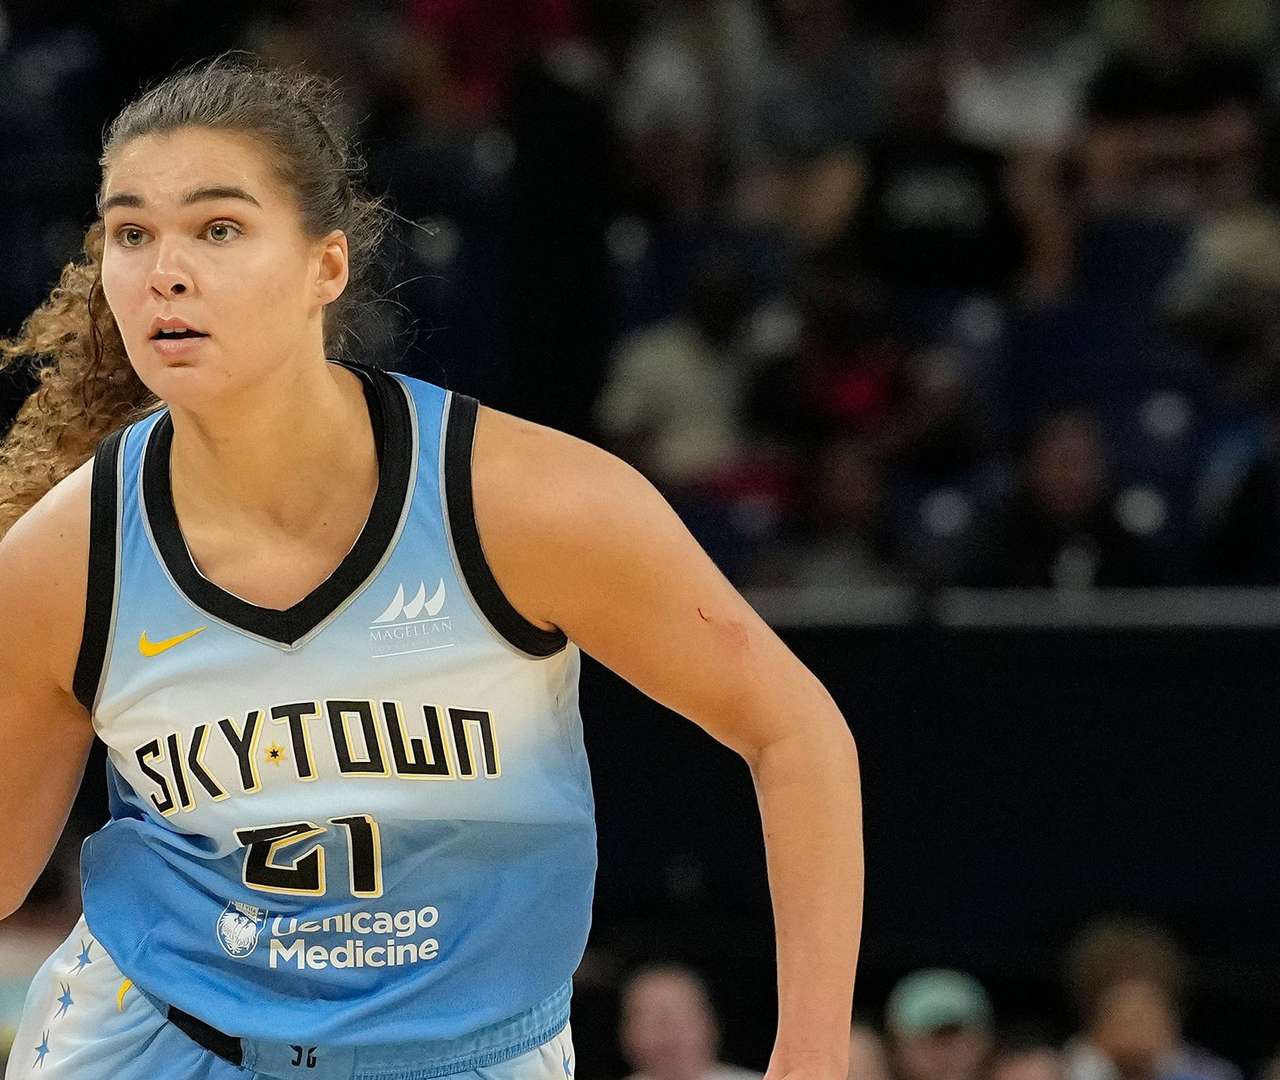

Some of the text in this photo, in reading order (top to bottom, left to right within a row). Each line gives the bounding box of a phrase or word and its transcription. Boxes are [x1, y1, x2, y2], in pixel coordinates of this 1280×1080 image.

[369, 619, 454, 641] MAGELLAN
[233, 813, 384, 899] 21
[269, 938, 439, 970] Medicine
